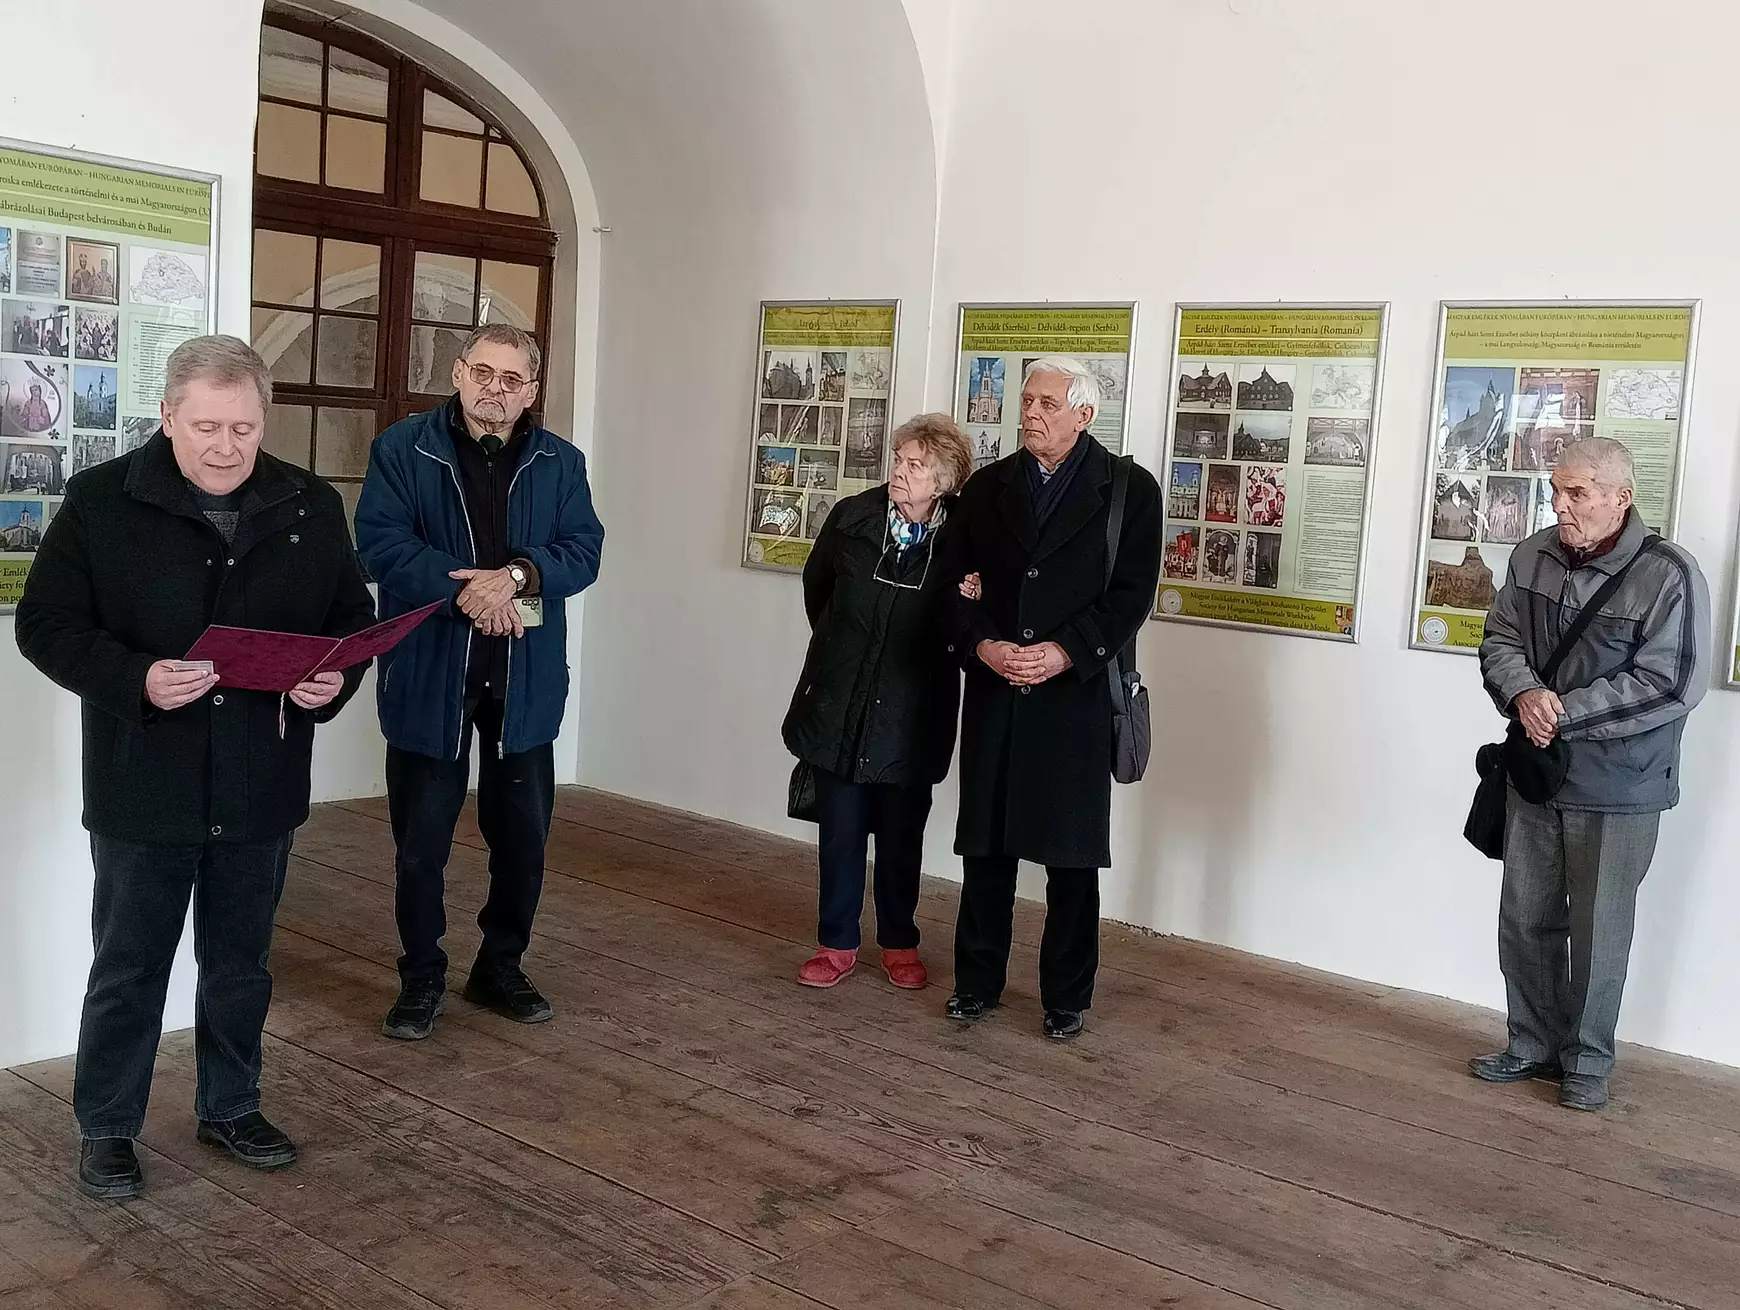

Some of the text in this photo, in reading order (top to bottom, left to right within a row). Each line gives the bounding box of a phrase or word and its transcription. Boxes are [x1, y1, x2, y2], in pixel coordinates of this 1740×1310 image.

[89, 171, 135, 186] HUNGARIAN
[135, 179, 176, 192] MEMORIALS
[21, 179, 63, 192] emlékezete
[71, 187, 110, 200] történelmi
[111, 193, 119, 201] és
[125, 196, 139, 204] mai
[140, 197, 198, 216] Magyarországon
[48, 207, 85, 222] Budapest
[86, 213, 137, 230] belvárosában
[147, 223, 172, 235] Budán
[973, 322, 1001, 331] Délvidék
[1092, 322, 1119, 333] (Serbia)
[1195, 324, 1218, 336] Erdély
[1220, 324, 1261, 335] (Románia)
[1269, 324, 1318, 336] Transylvania
[1320, 325, 1364, 336] (Romania)
